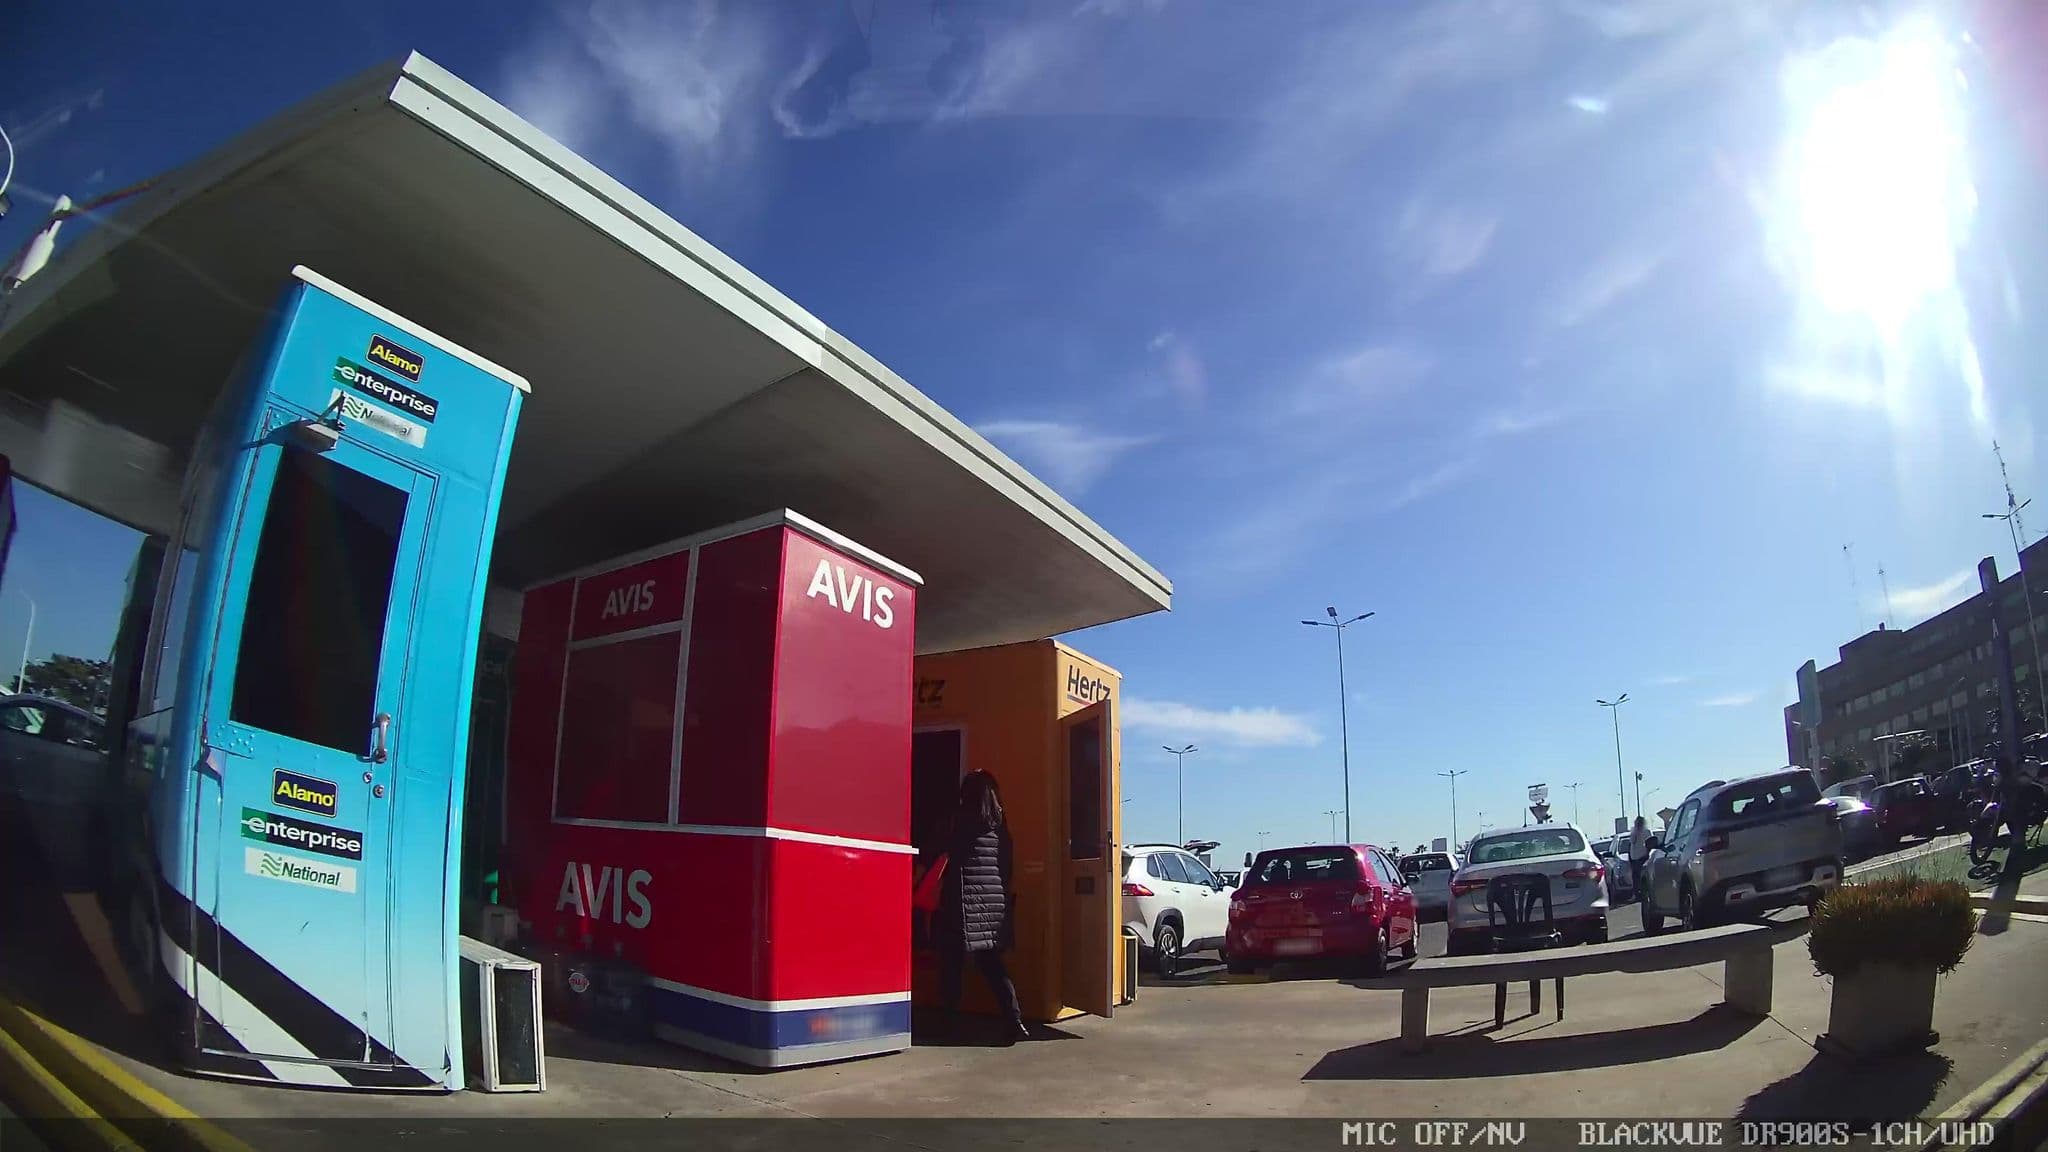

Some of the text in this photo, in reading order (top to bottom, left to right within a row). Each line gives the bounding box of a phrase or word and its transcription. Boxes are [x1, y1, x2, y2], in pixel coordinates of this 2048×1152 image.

[370, 344, 419, 374] Alamo
[334, 365, 435, 416] enterprise
[602, 580, 656, 620] AVIS
[806, 559, 894, 629] AVIS
[1067, 664, 1111, 701] Hertz
[276, 780, 334, 807] Alamo
[240, 817, 361, 852] enterprise
[281, 862, 341, 886] National
[556, 861, 653, 929] AVIS
